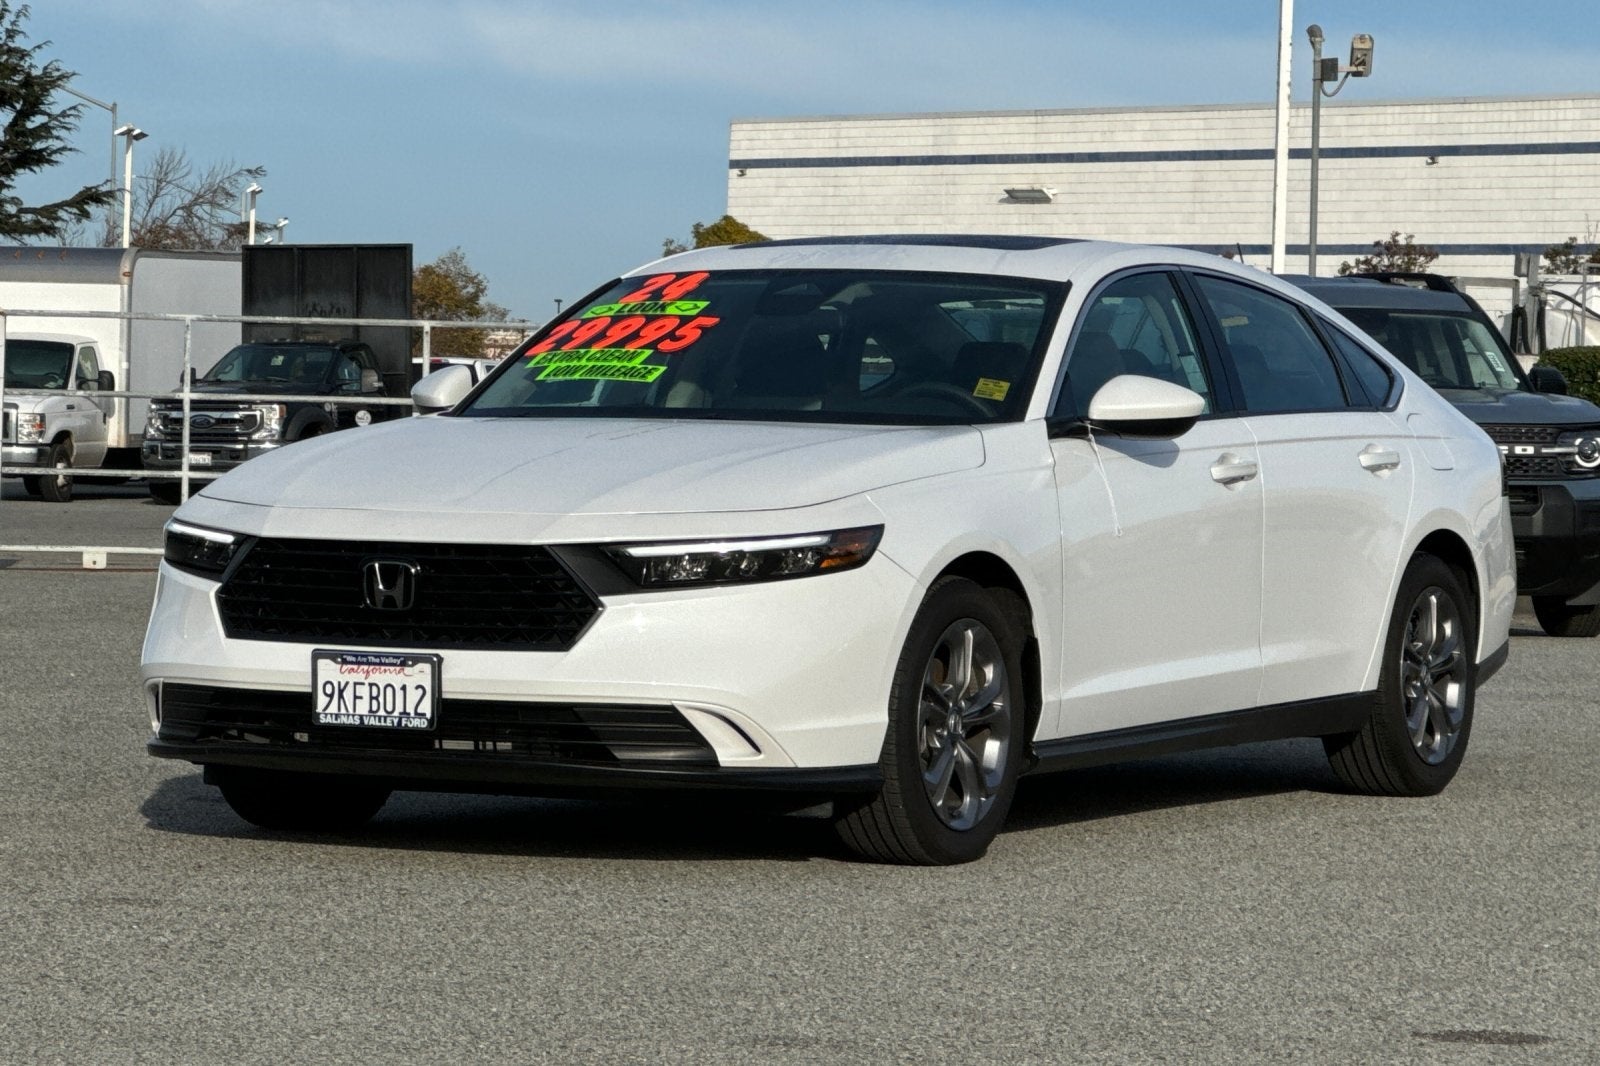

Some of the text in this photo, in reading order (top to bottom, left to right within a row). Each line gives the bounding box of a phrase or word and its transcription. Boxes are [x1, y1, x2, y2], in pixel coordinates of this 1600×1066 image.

[619, 270, 710, 303] 24
[614, 302, 671, 314] LOOK
[525, 315, 720, 355] 29995
[579, 364, 657, 379] MILEAGE
[339, 663, 414, 681] California
[322, 680, 427, 718] 9KFB012
[319, 713, 428, 728] SALINAS VALLEY FORD
